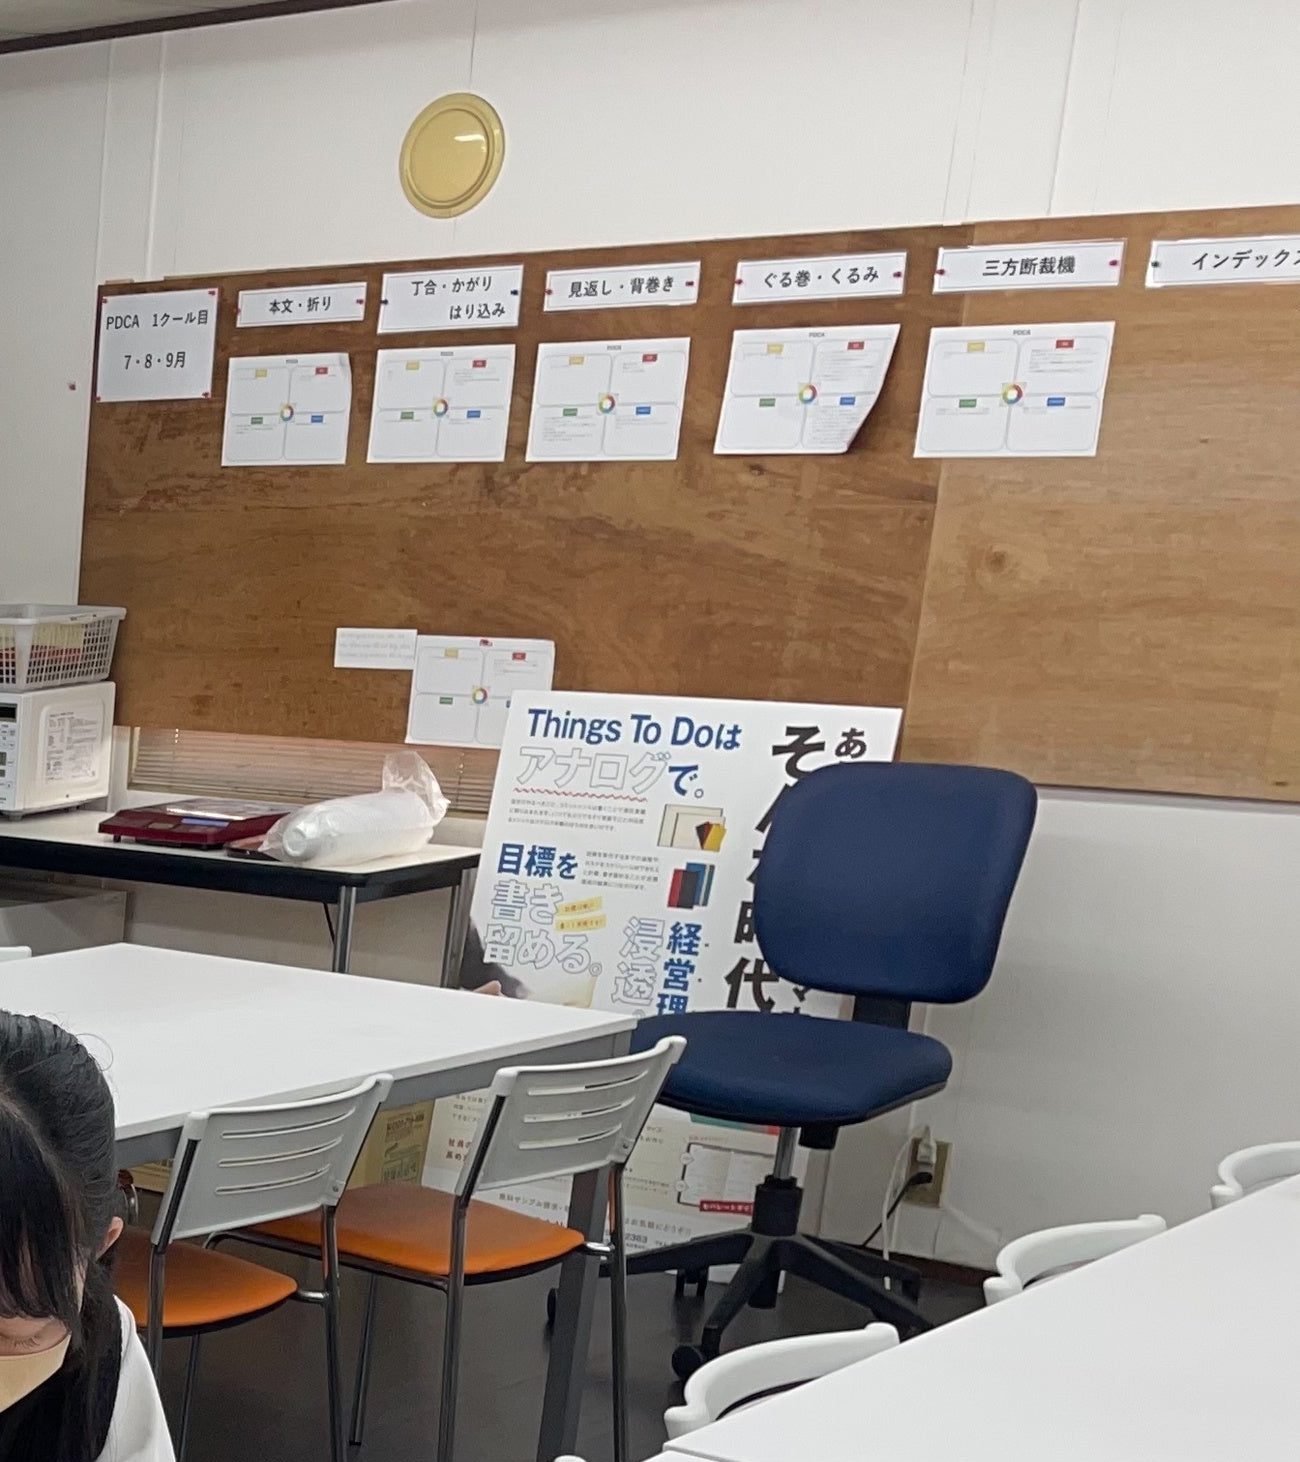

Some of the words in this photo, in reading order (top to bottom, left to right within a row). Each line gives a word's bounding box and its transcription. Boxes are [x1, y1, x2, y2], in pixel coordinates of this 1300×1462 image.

[763, 266, 879, 288] ぐる巻・くるみ
[982, 255, 1076, 277] 三方断裁機
[411, 276, 493, 297] 丁合・かがり
[568, 276, 674, 298] 見返し・背巻き
[268, 297, 333, 314] 本文・折り
[449, 302, 506, 320] はり込み
[106, 316, 140, 330] PDCA
[152, 310, 209, 328] 1クール目
[124, 352, 186, 370] 7・8・9月
[528, 708, 622, 745] Things
[630, 714, 662, 744] To
[516, 746, 704, 799] アナログで。
[497, 843, 578, 880] 目標を
[491, 879, 564, 925] 書き
[483, 923, 603, 976] 留める。
